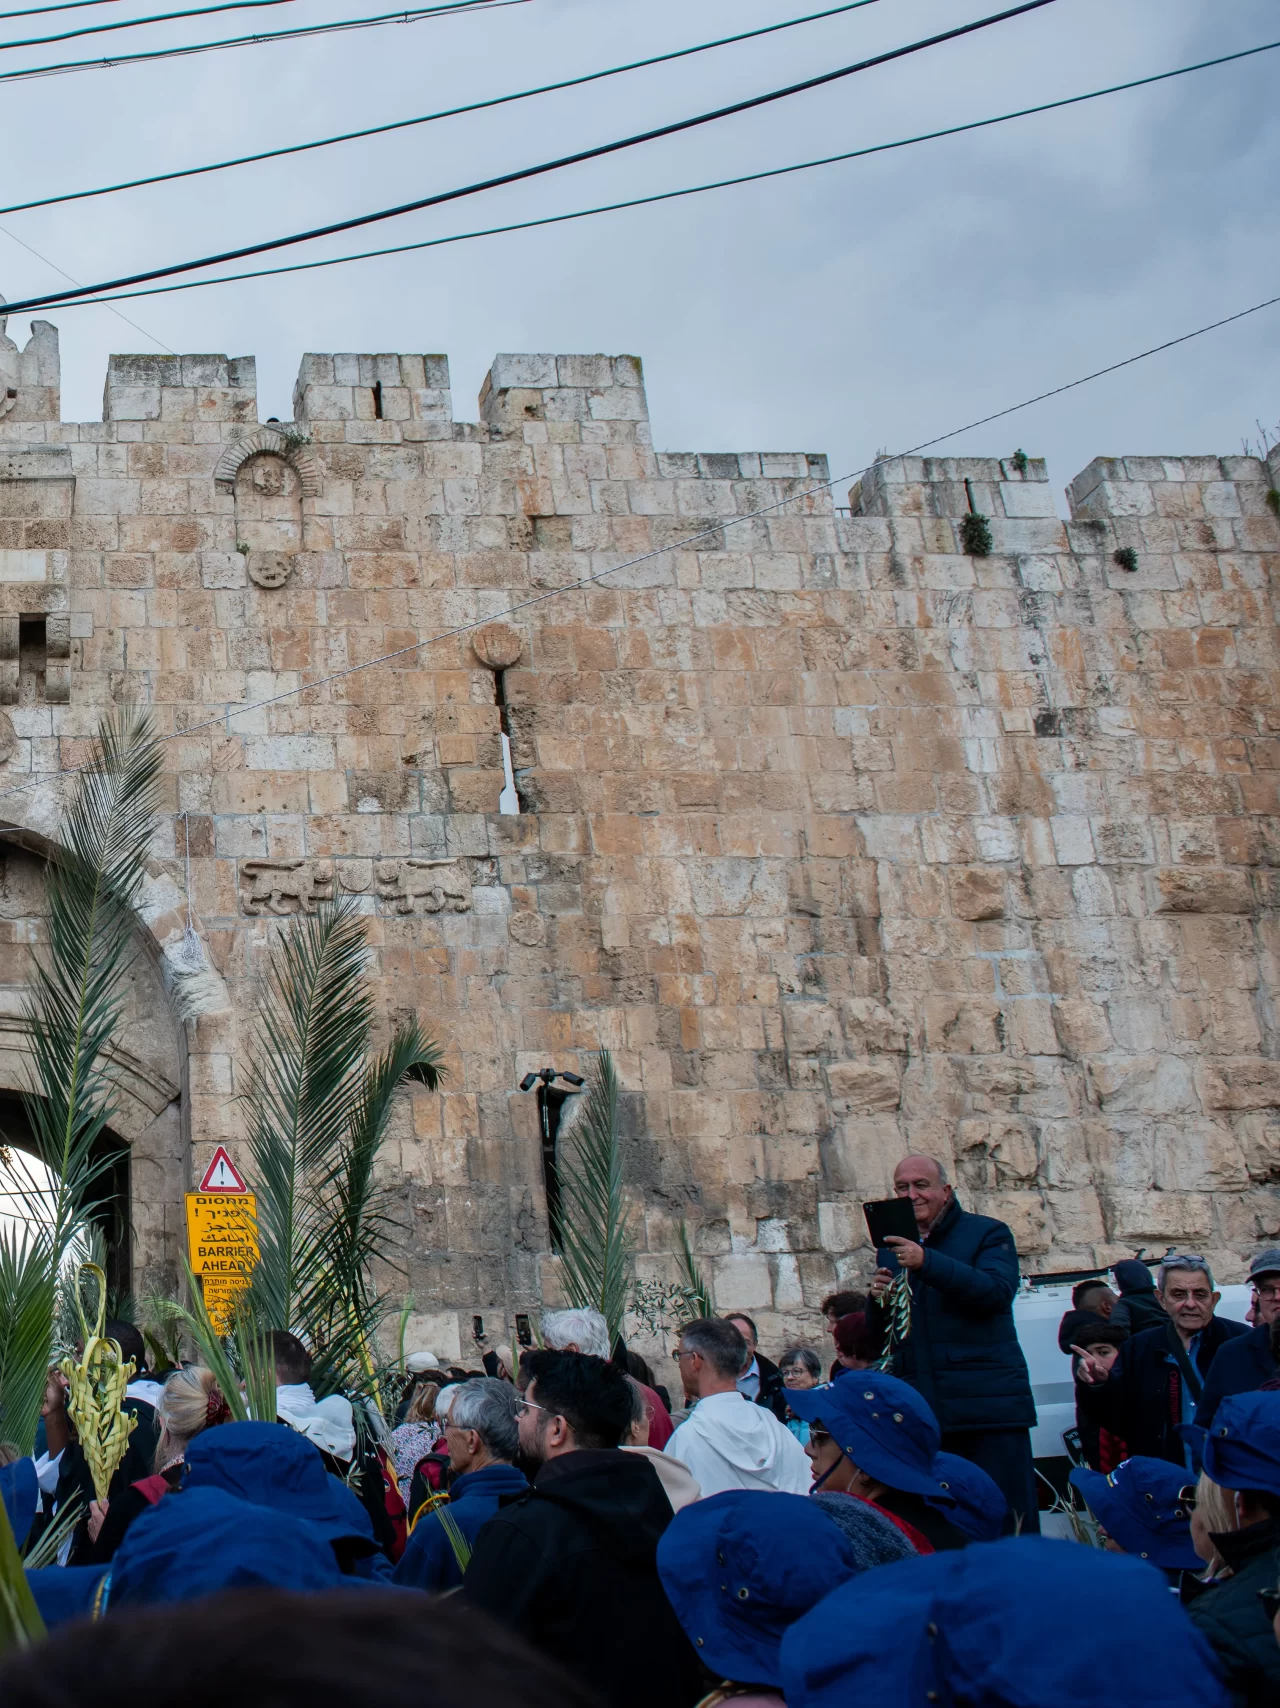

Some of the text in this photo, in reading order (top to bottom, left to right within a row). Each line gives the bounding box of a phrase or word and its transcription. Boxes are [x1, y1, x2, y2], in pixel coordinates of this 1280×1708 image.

[196, 1197, 249, 1205] מחסום
[201, 1222, 248, 1233] حاجز
[198, 1246, 254, 1257] BARRIER
[202, 1260, 246, 1271] AHEAD
